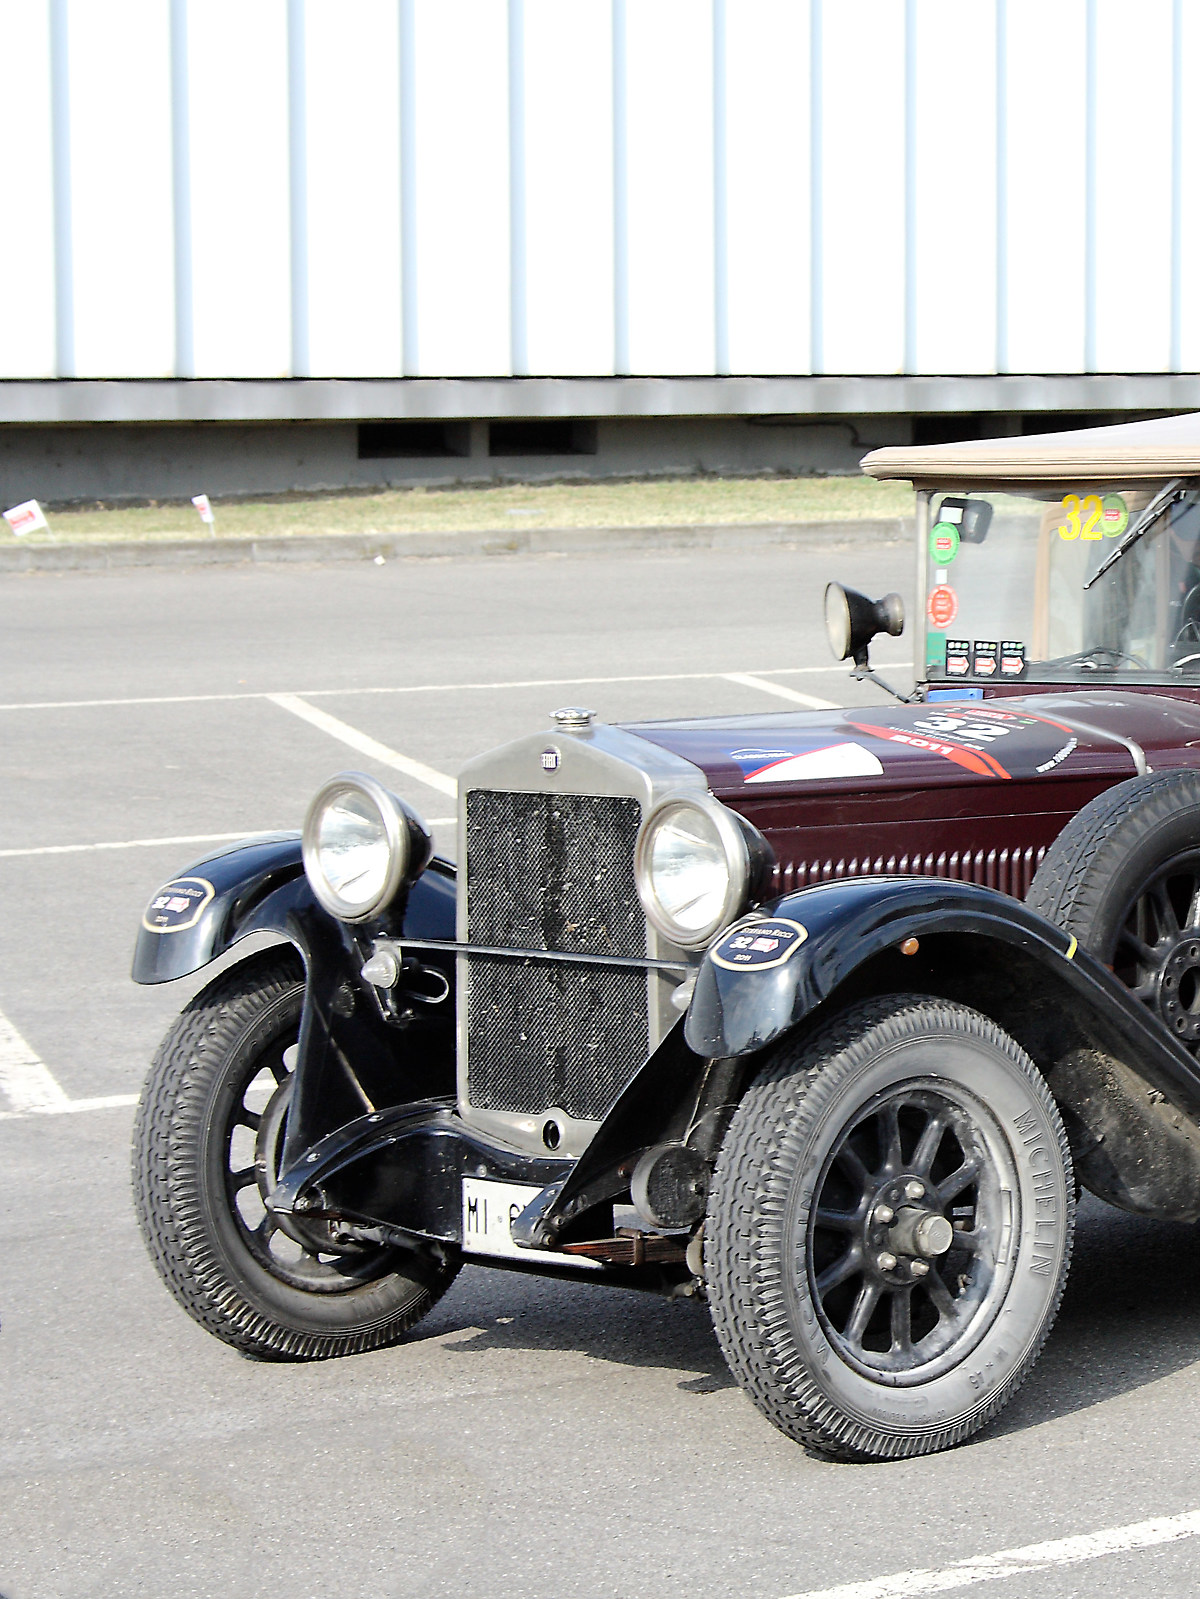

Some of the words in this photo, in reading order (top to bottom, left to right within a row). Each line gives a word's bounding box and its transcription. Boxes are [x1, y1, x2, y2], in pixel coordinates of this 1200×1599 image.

[1058, 494, 1103, 540] 32
[889, 734, 954, 755] 2011
[913, 716, 1010, 742] 32
[1013, 1108, 1057, 1278] MICHELIN
[467, 1196, 488, 1235] MI
